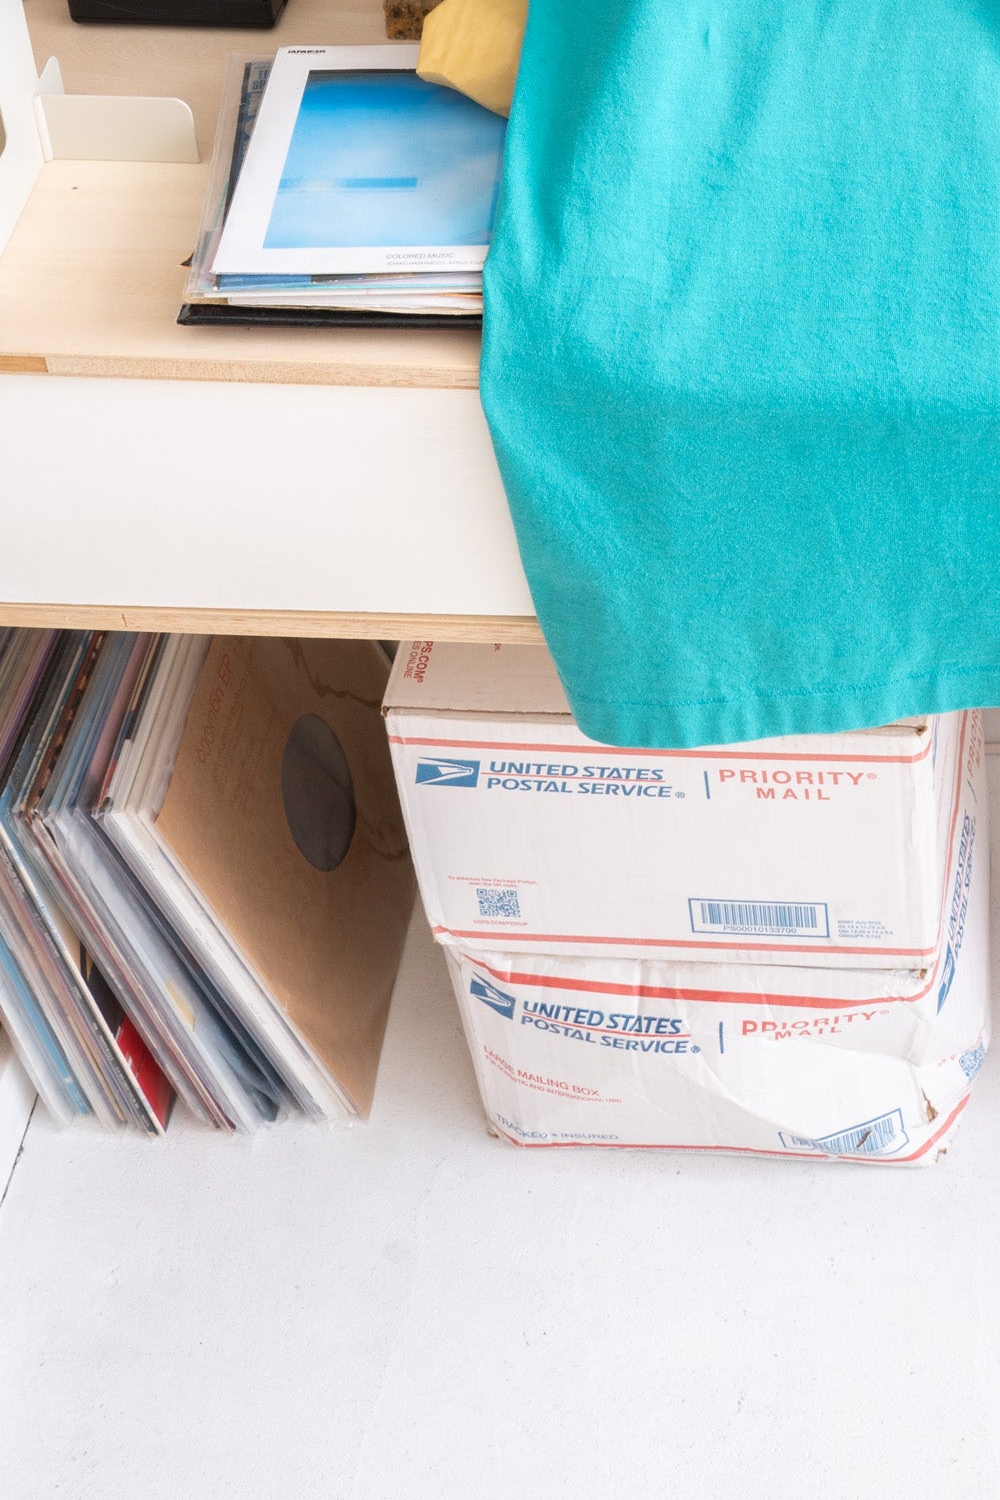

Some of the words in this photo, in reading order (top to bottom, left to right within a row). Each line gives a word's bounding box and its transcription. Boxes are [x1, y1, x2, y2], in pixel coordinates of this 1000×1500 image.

[427, 252, 455, 260] MUSIC
[403, 651, 419, 679] ONLINE
[489, 760, 579, 777] UNITED
[582, 765, 665, 781] STATES
[486, 777, 573, 794] POSTAL
[756, 787, 831, 801] MAIL
[948, 870, 962, 941] UNITED
[723, 925, 797, 934] PS00010133700
[954, 894, 968, 960] POSTAL
[521, 1015, 597, 1044] POSTAL
[523, 1001, 605, 1028] UNITED
[606, 1012, 683, 1035] STATES
[774, 1025, 843, 1041] MAIL
[517, 1069, 570, 1091] MAILING
[572, 1085, 600, 1097] BOX
[495, 1112, 548, 1139] TRACKED
[560, 1132, 619, 1140] INSURED
